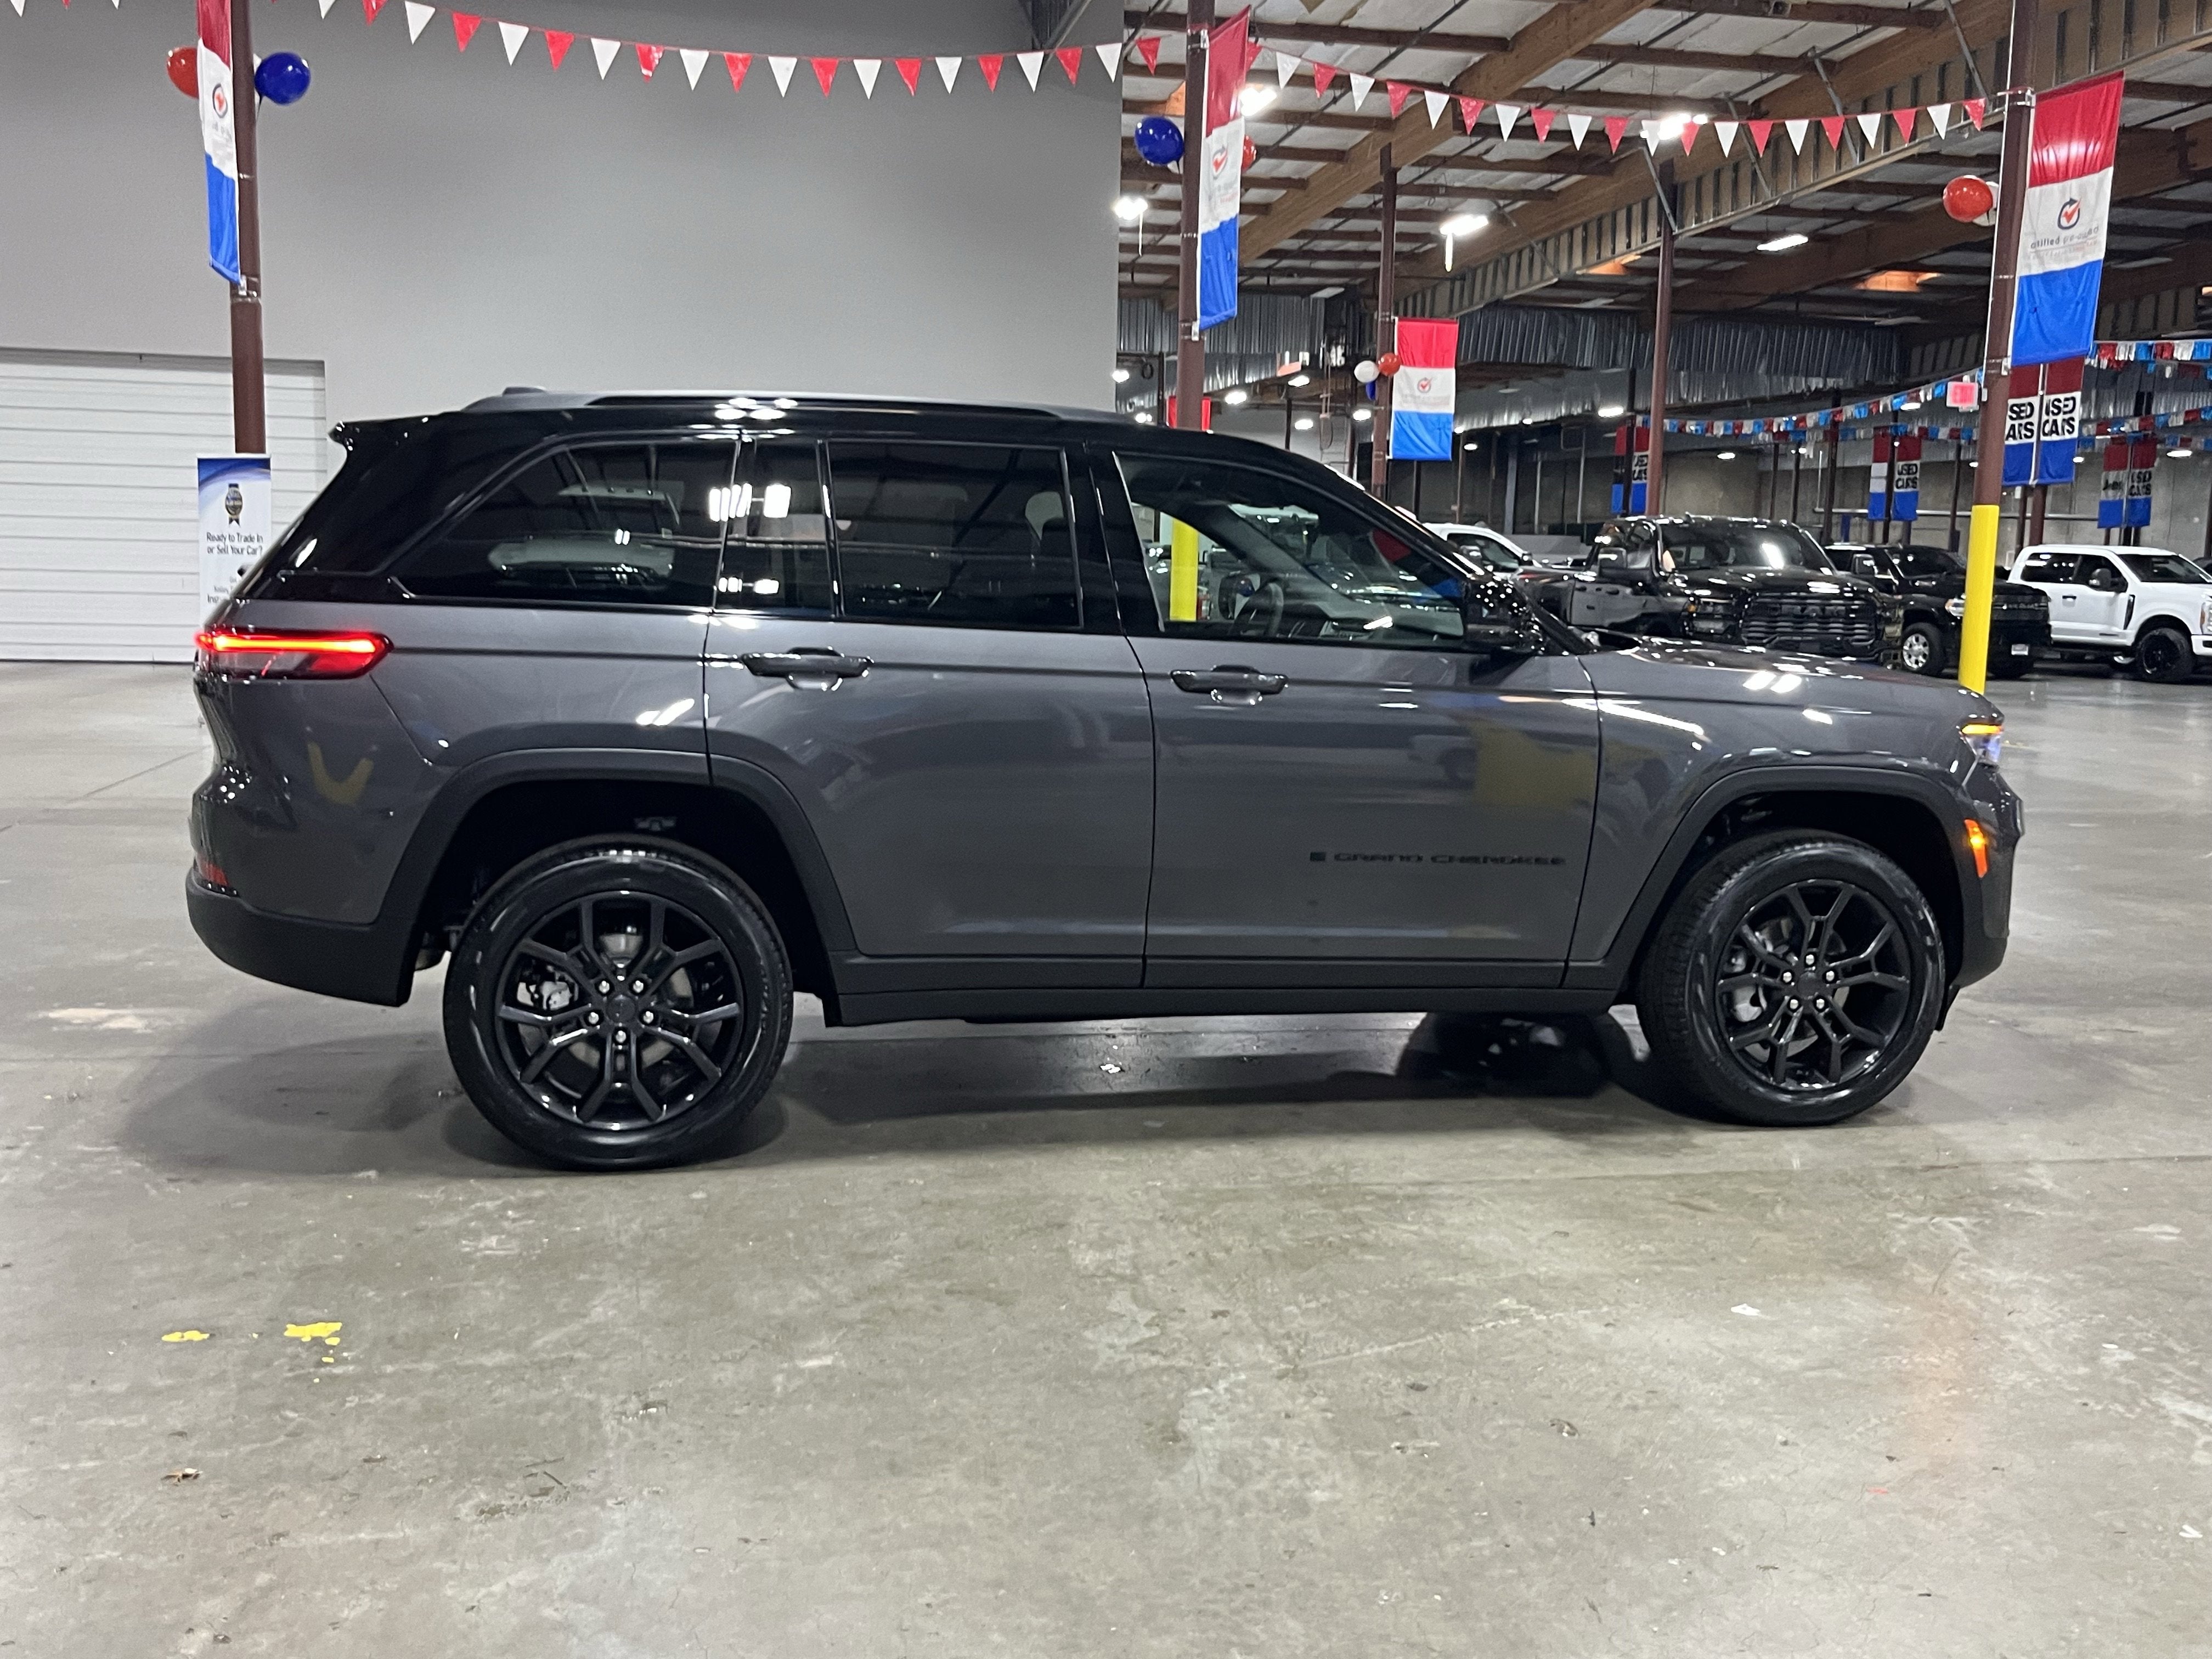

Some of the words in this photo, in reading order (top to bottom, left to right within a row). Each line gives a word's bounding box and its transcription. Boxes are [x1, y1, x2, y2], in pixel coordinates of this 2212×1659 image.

[2008, 402, 2034, 421] SED
[2005, 421, 2034, 441] ARS
[206, 532, 227, 546] Ready
[228, 533, 235, 542] to
[237, 532, 255, 543] Trade
[207, 546, 215, 554] or
[217, 544, 229, 554] Sell
[230, 544, 245, 555] Your
